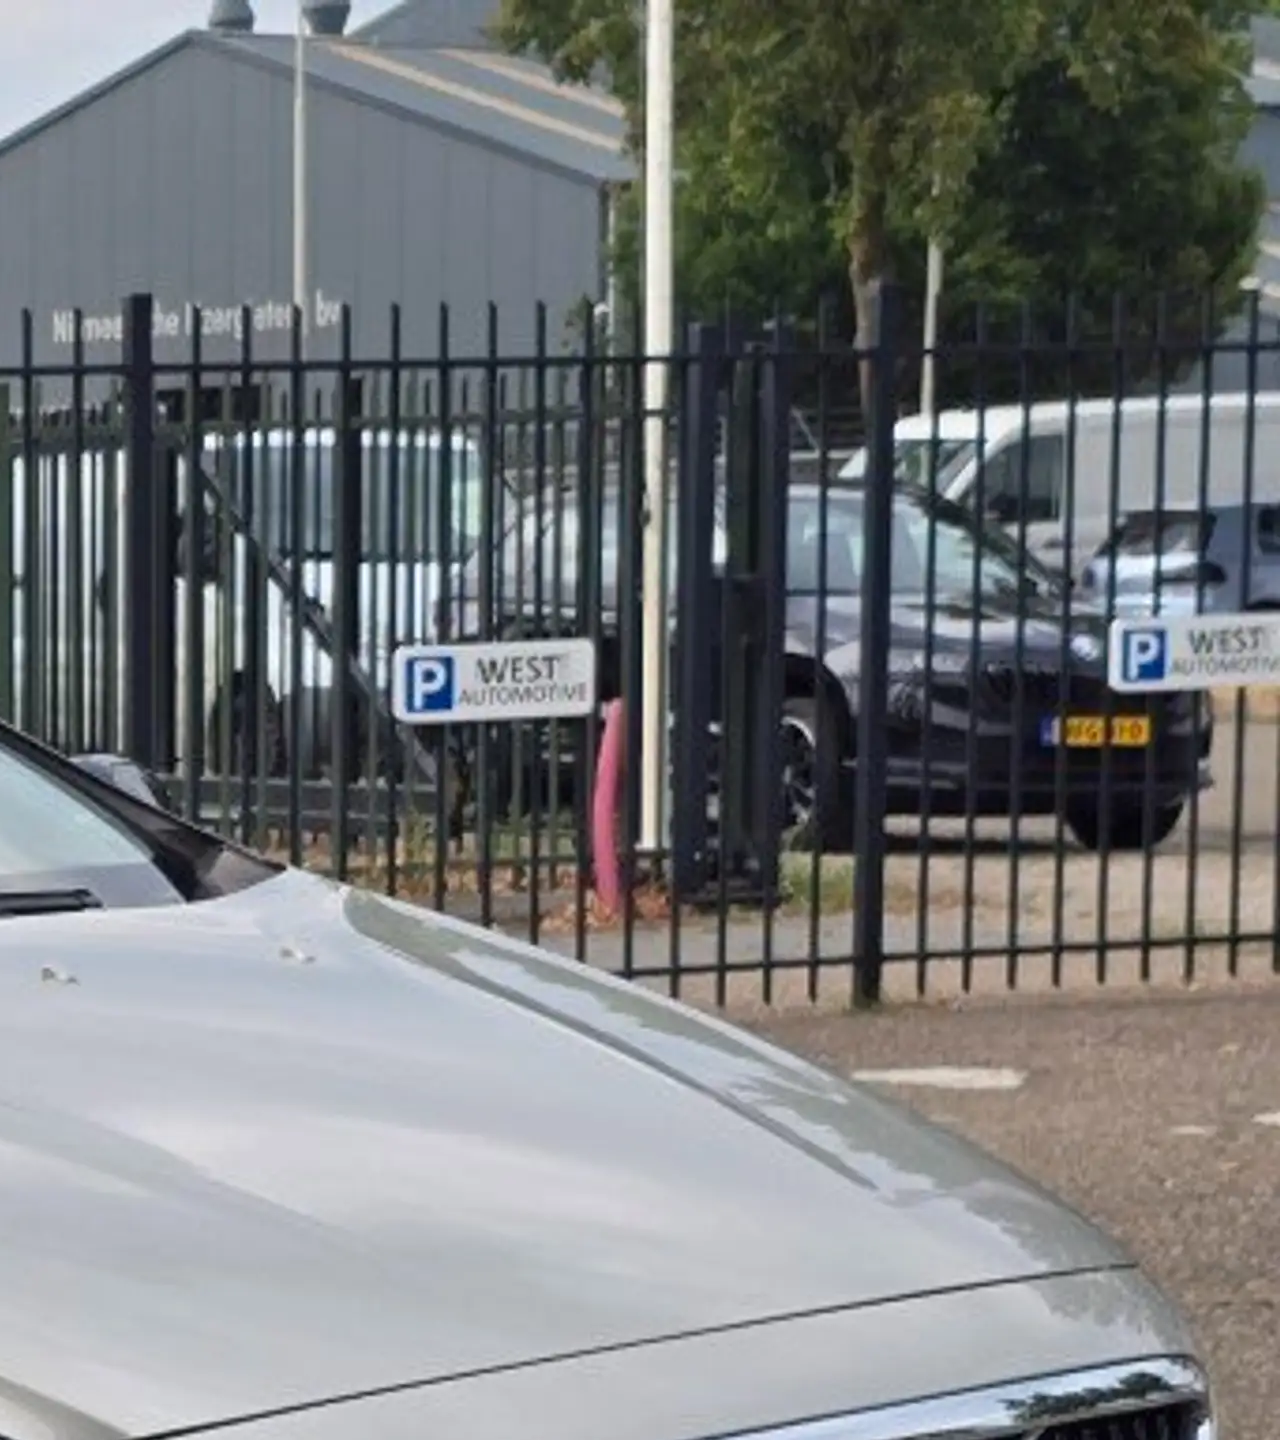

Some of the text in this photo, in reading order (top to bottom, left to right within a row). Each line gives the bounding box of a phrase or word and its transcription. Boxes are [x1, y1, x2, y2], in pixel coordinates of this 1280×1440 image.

[1188, 627, 1263, 654] WEST
[476, 656, 558, 684] WEST
[1171, 654, 1280, 678] AUTOMOTIV
[459, 682, 587, 707] AUTOMOTIVE
